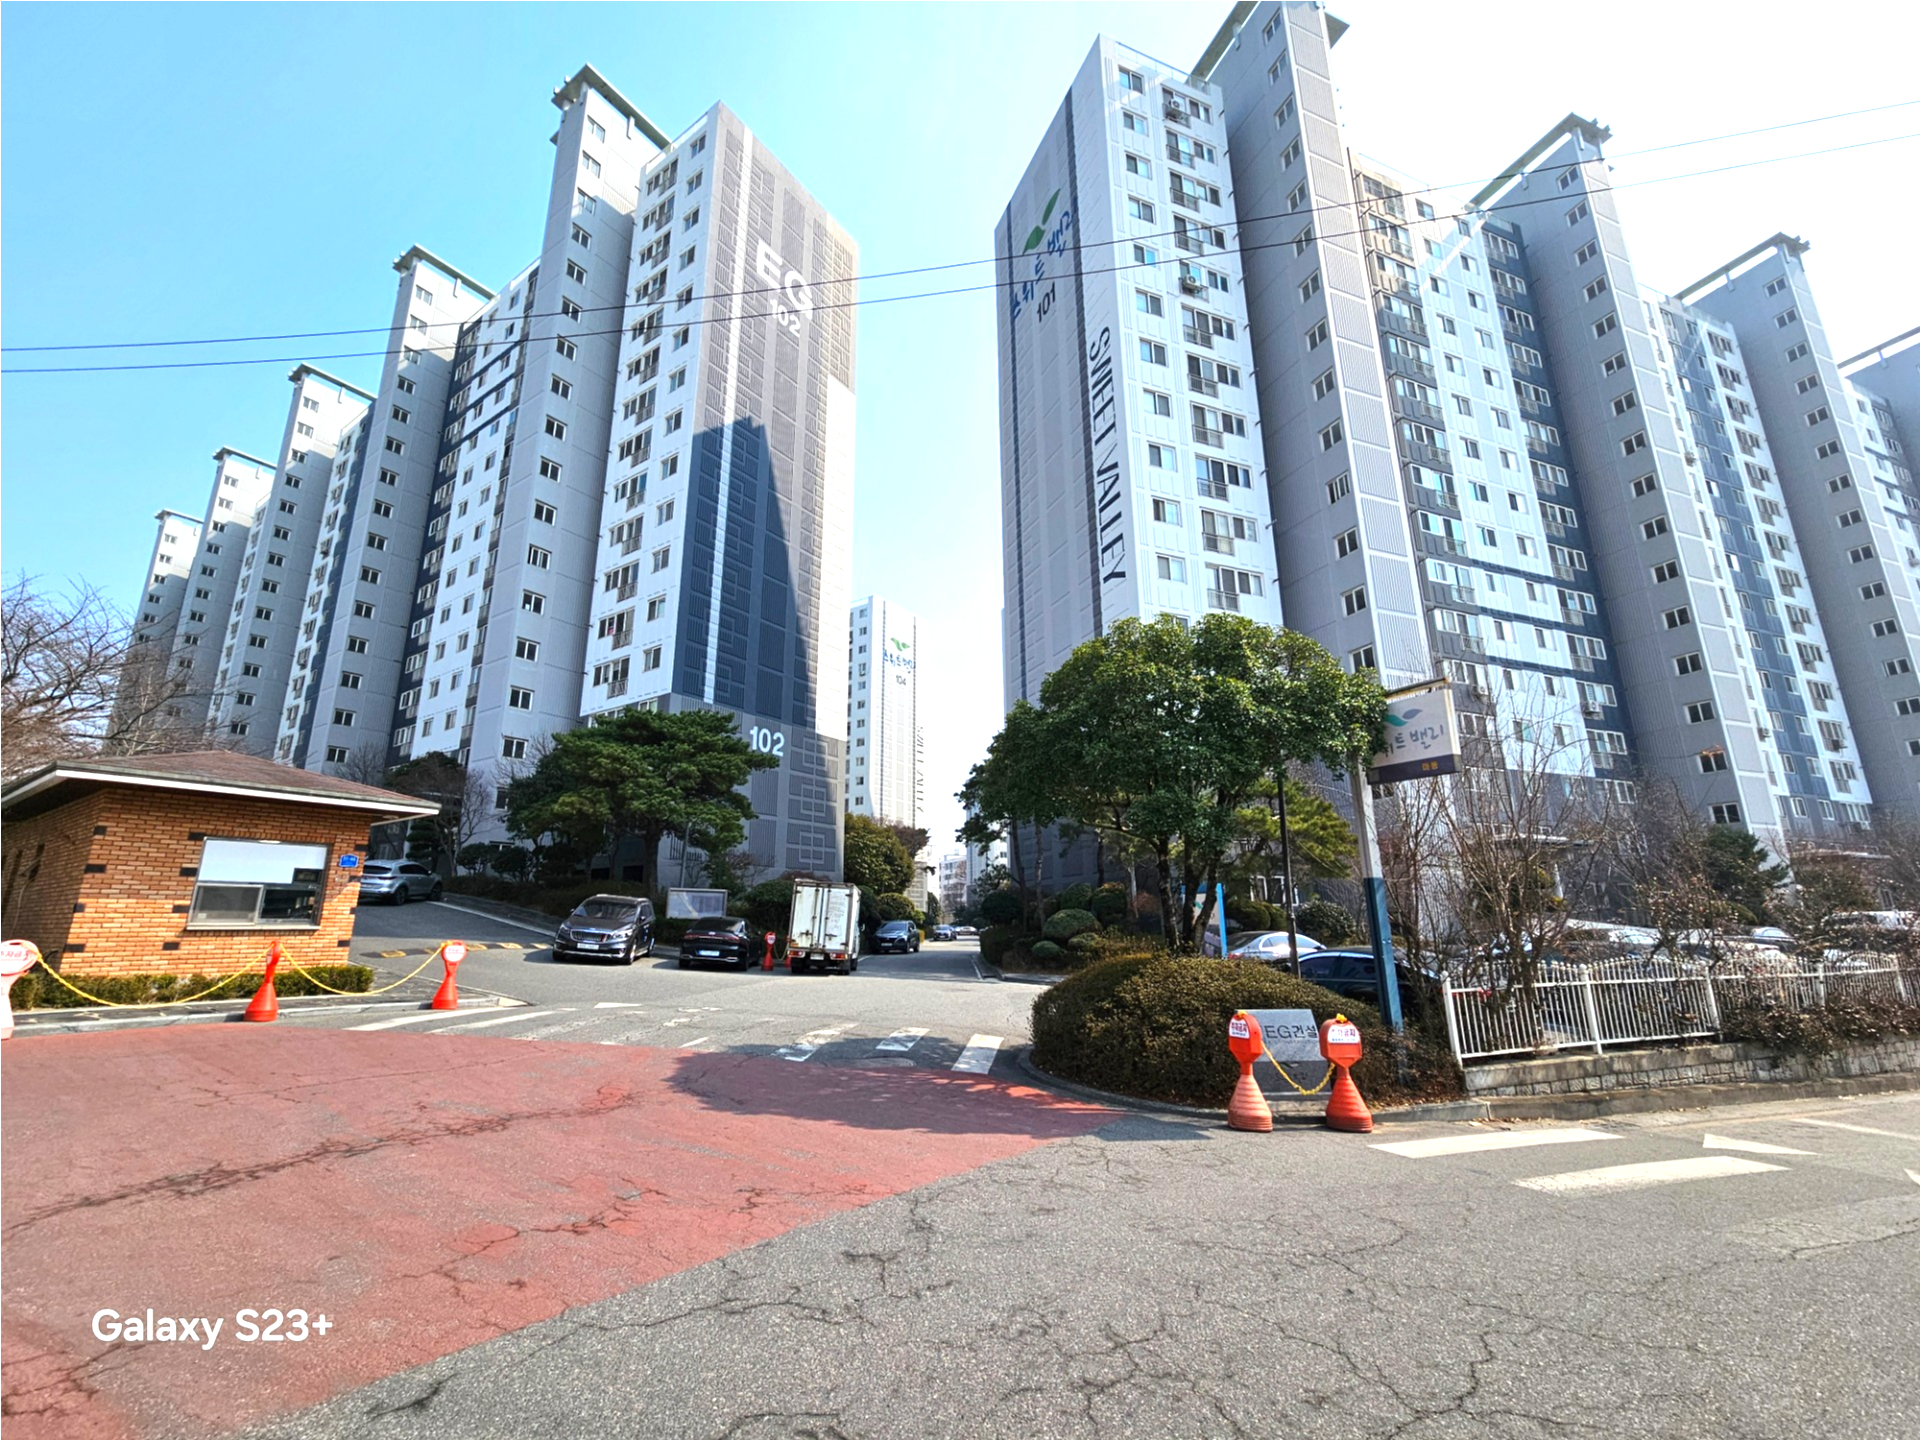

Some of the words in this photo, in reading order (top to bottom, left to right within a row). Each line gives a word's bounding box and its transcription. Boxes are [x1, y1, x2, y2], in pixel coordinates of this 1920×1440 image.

[756, 239, 814, 320] EG
[769, 298, 801, 338] 102
[1037, 281, 1056, 323] 101
[1089, 326, 1117, 446] SWEET
[1096, 443, 1127, 584] VALLEY
[750, 726, 785, 757] 102
[1410, 724, 1444, 749] 밸리
[1264, 1025, 1318, 1039] EG건설
